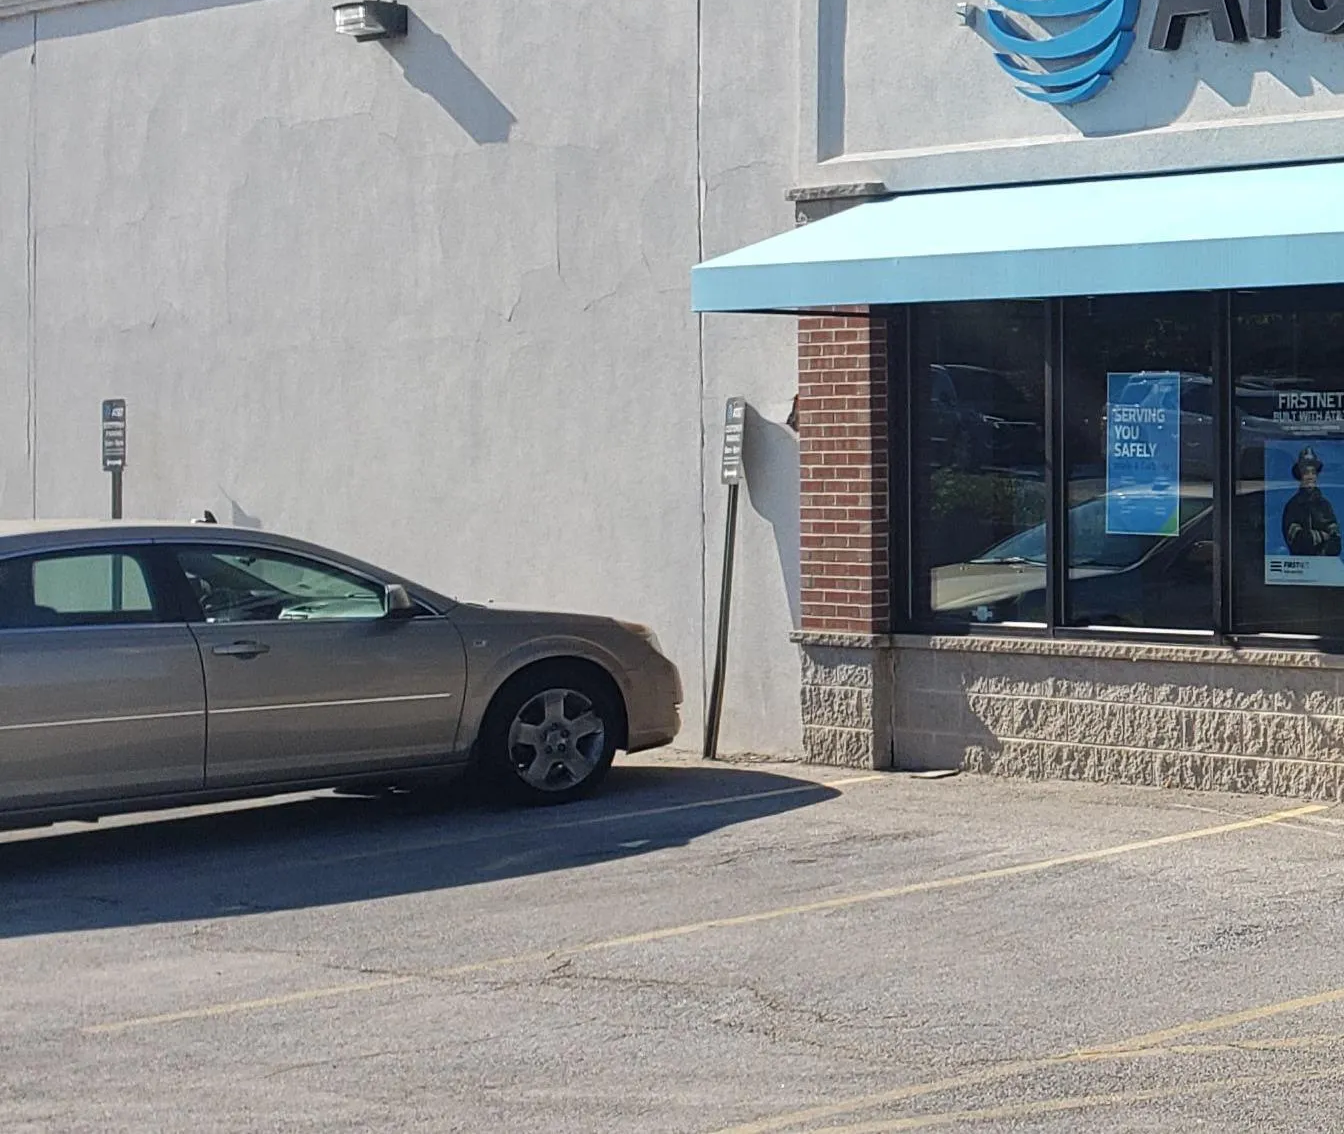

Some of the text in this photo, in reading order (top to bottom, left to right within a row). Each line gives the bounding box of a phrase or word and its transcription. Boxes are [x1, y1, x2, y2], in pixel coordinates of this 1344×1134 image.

[1113, 408, 1166, 423] SERVING
[1299, 411, 1323, 423] WITH
[1114, 425, 1140, 440] YOU
[1113, 443, 1157, 458] SAFELY
